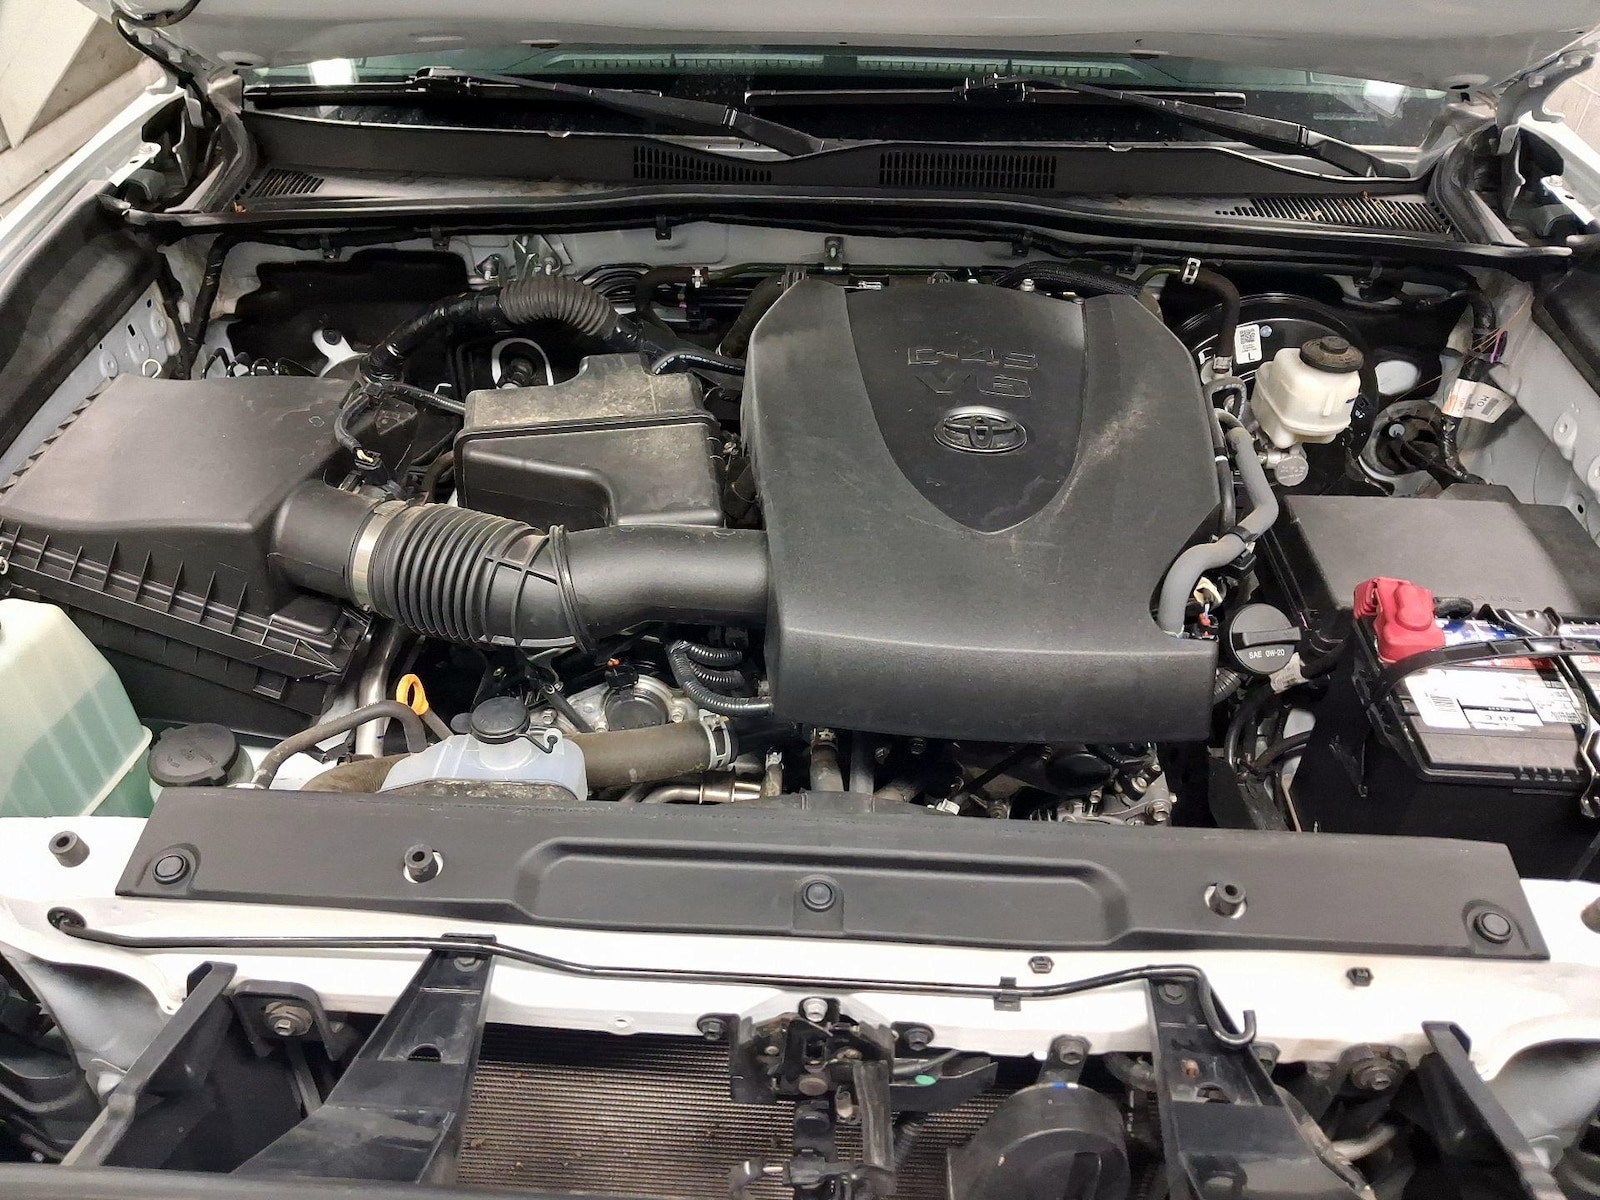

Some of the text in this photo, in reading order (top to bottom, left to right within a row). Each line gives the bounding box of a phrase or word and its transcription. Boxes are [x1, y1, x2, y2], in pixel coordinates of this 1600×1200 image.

[914, 369, 1033, 399] V6
[1248, 648, 1285, 660] SAE 0W-20
